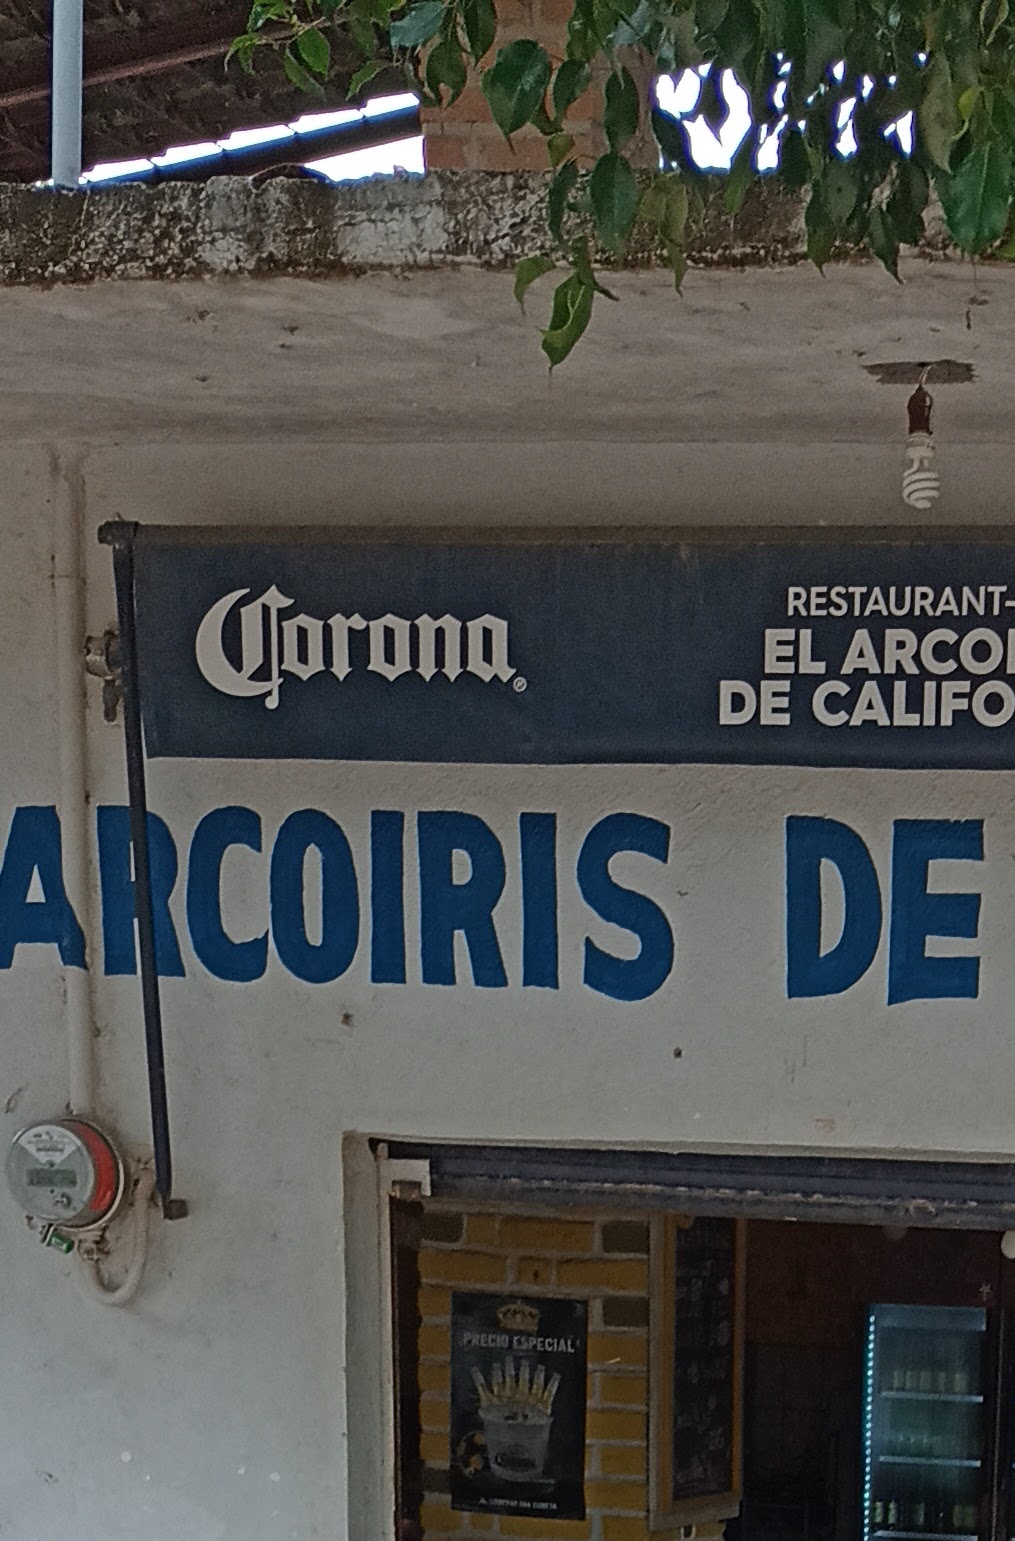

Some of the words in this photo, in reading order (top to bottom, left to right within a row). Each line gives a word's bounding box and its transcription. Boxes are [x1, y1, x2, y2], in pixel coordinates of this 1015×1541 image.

[195, 584, 517, 710] Corona
[764, 628, 826, 674] EL
[719, 680, 791, 726] DE
[0, 805, 674, 1001] ARCOIRIS
[786, 816, 986, 1006] DE
[463, 1332, 509, 1348] PRECIO
[513, 1334, 575, 1353] ESPECIAL
